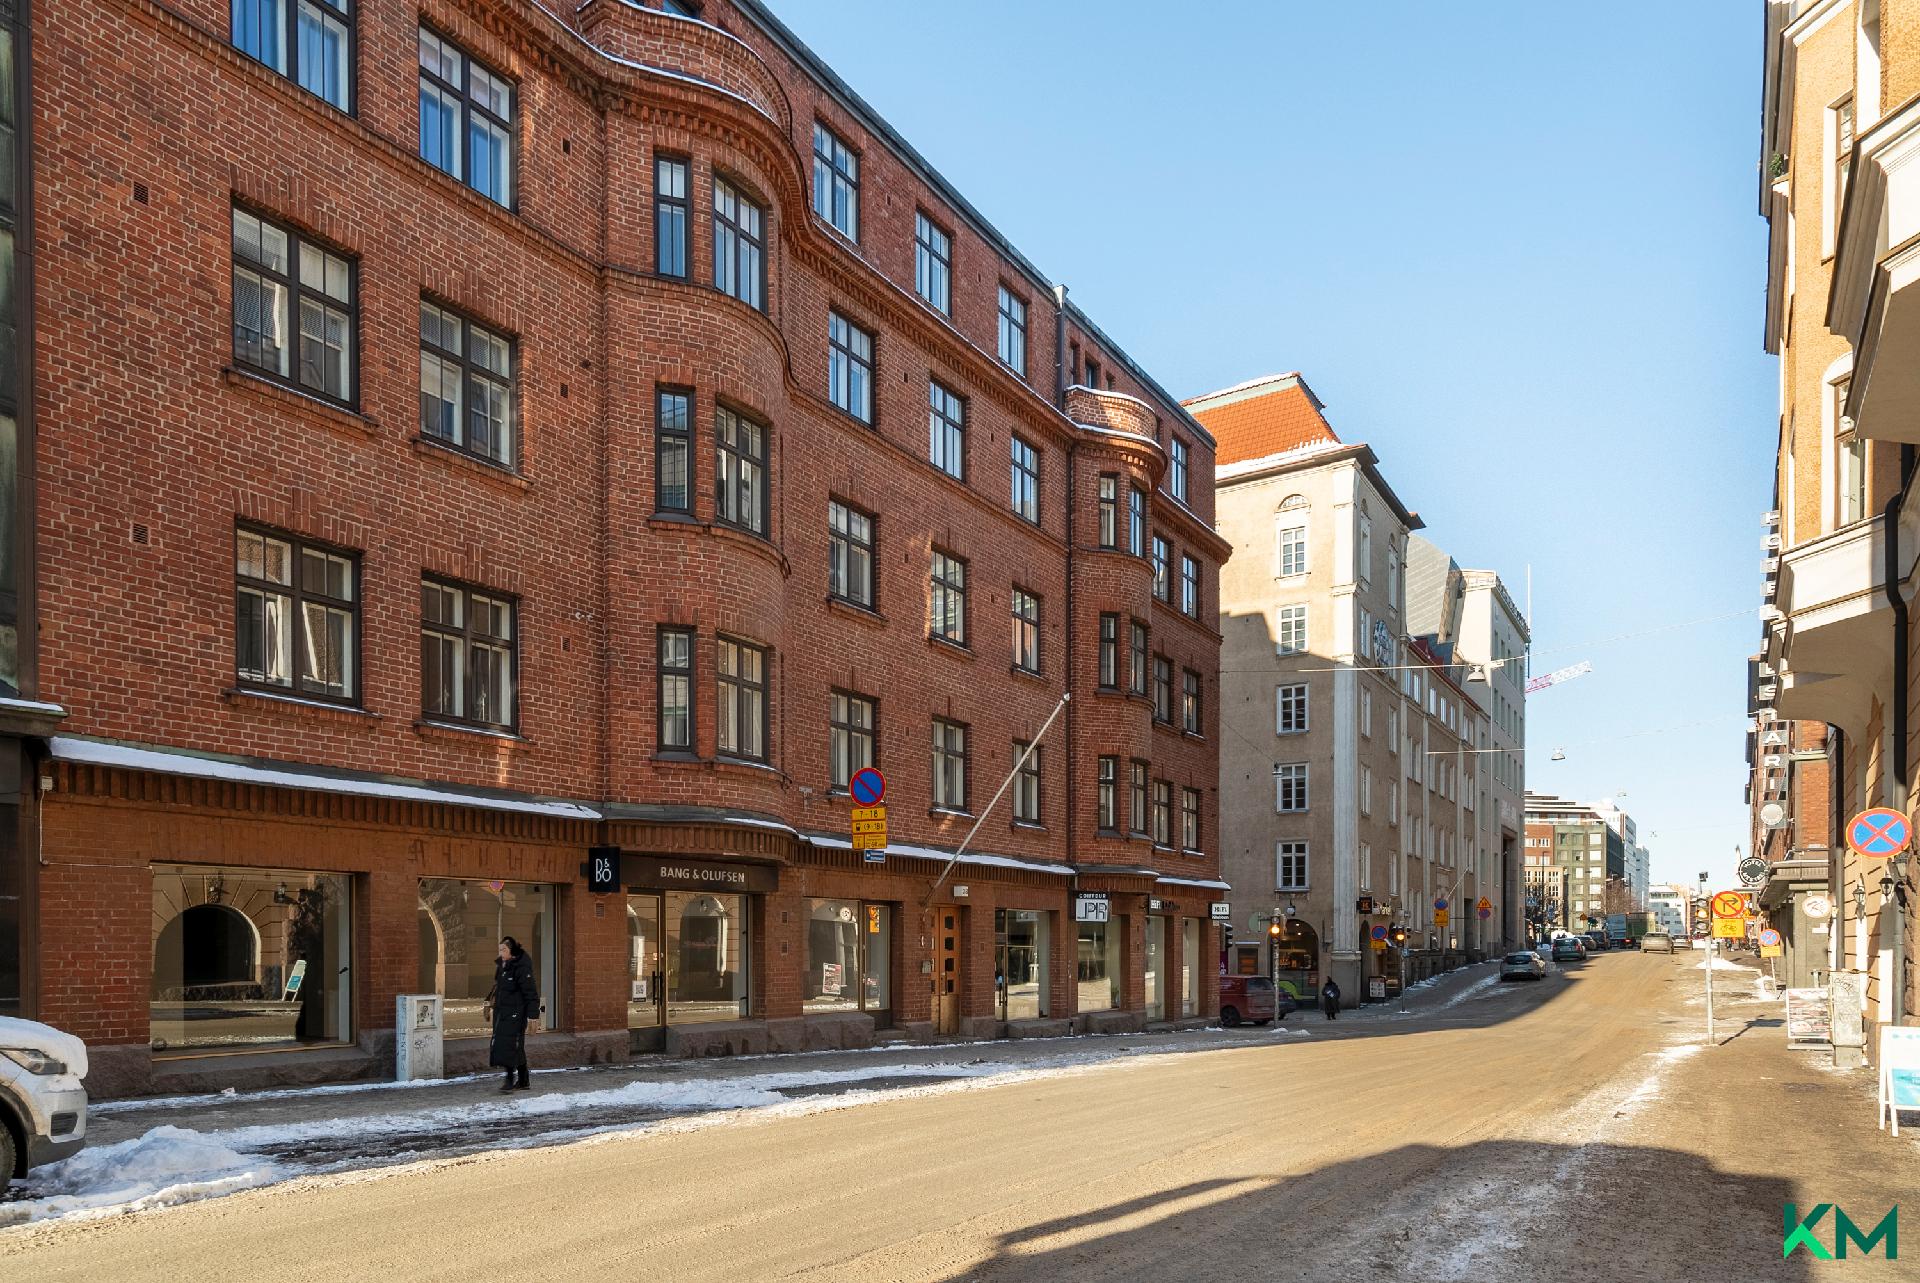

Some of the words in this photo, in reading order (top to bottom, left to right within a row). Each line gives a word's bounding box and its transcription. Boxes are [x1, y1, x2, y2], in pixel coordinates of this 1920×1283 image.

[660, 866, 690, 879] BANG
[692, 869, 700, 880] &
[701, 869, 745, 883] OLUFSEN
